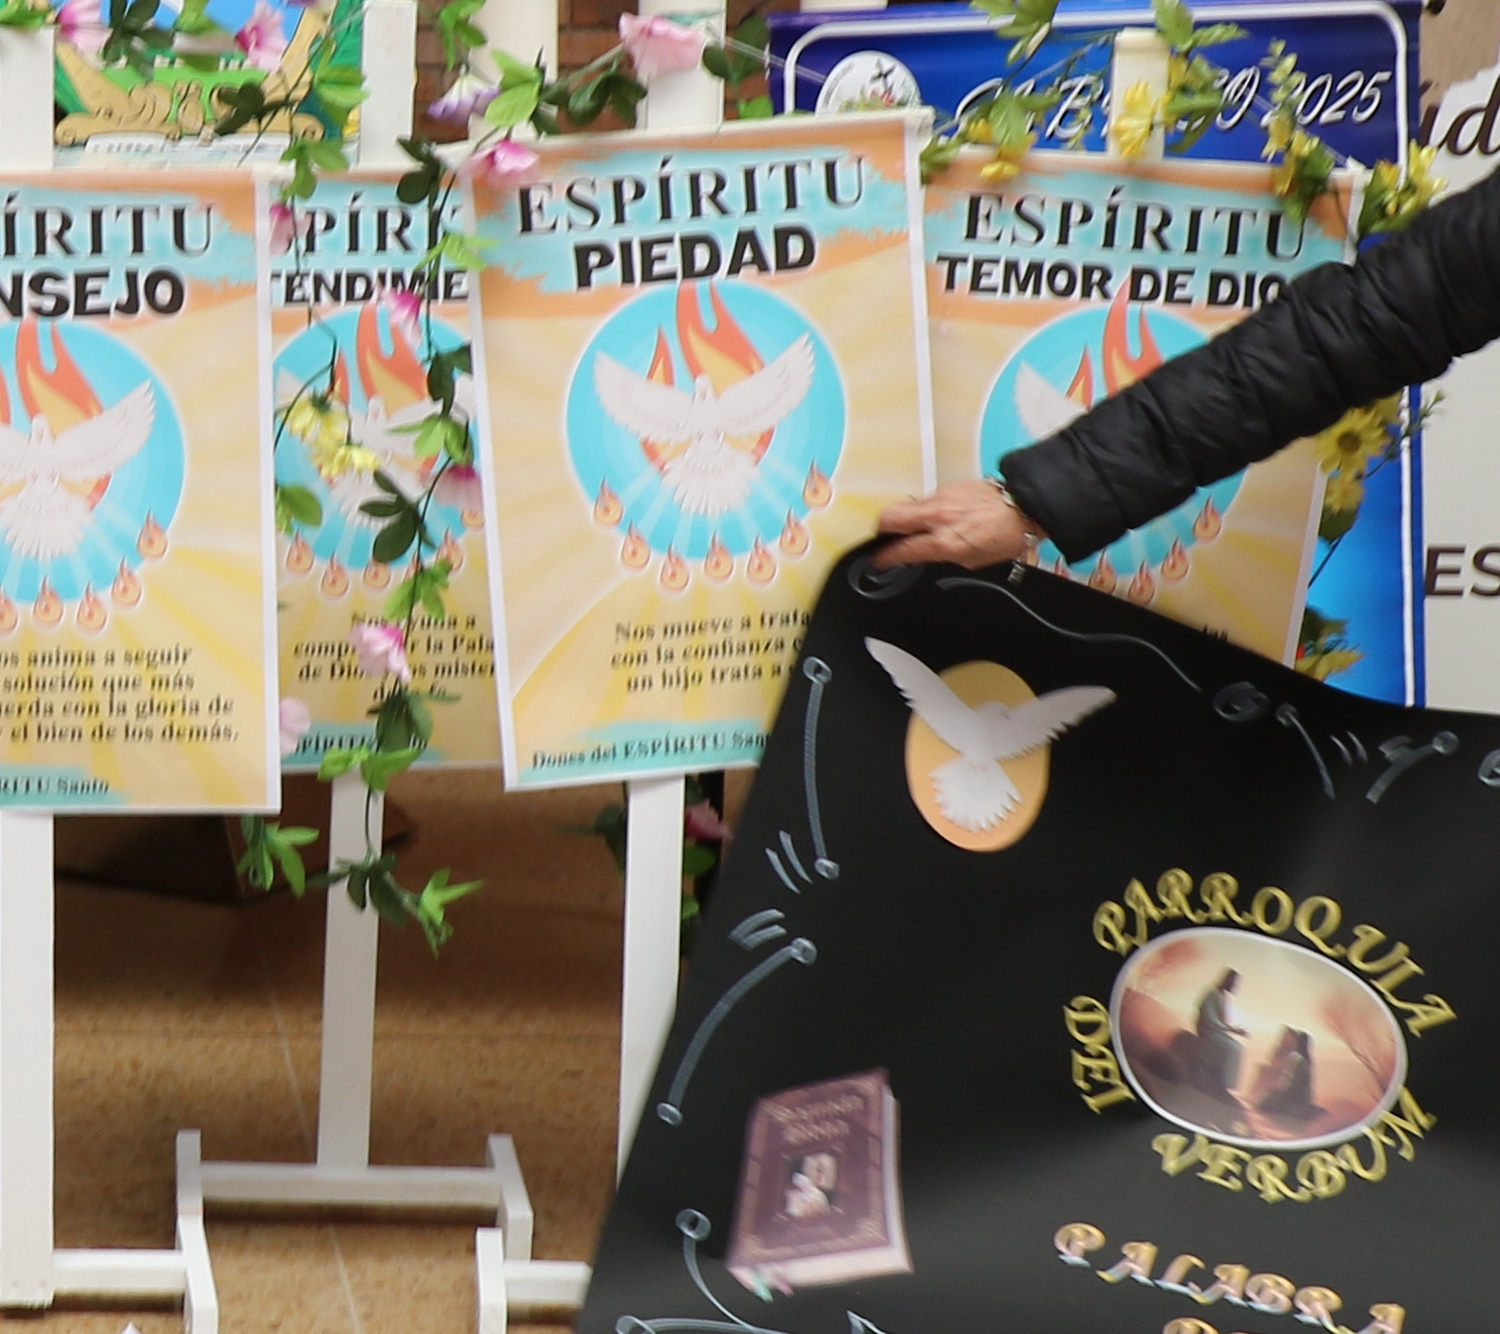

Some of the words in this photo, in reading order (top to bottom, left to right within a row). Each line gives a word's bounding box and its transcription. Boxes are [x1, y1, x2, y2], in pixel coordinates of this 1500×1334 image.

[517, 153, 866, 238] ESPÍRITU
[964, 186, 1306, 261] ESPÍRITU
[573, 226, 817, 292] PIEDAD
[936, 254, 1113, 301] TEMOR
[1128, 266, 1196, 305] DE
[2, 670, 95, 694] solución
[101, 673, 143, 698] que
[150, 670, 196, 692] más
[26, 645, 98, 667] anima
[103, 650, 117, 666] a
[123, 643, 194, 671] seguir
[10, 720, 29, 742] el
[35, 721, 83, 742] bien
[91, 719, 118, 742] de
[124, 719, 155, 742] los
[61, 699, 101, 719] con
[108, 694, 129, 717] la
[135, 694, 202, 721] gloria
[208, 693, 235, 716] de
[1093, 867, 1457, 1038] PARROQUIA
[1063, 994, 1136, 1114] DEL
